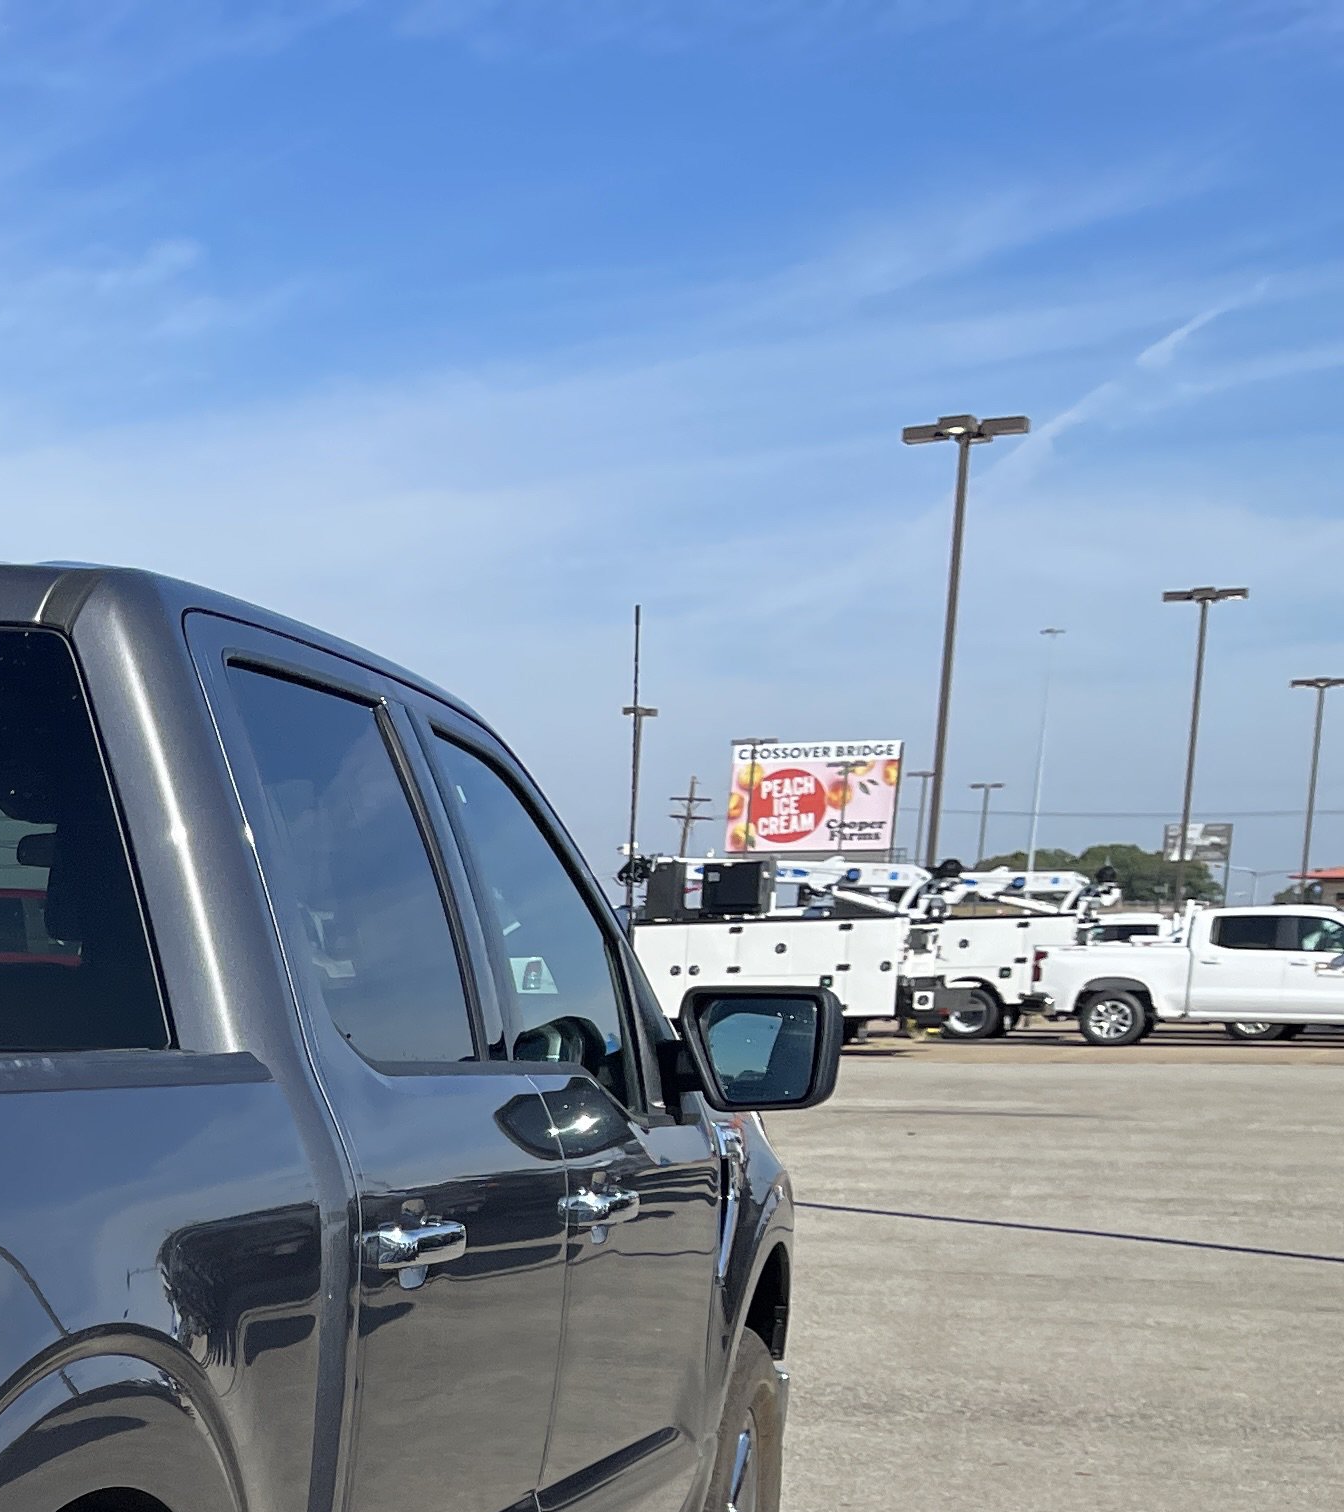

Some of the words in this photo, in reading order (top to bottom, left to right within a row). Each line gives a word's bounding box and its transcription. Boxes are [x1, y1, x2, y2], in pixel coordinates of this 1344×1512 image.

[738, 747, 830, 760] CROSSOVER
[836, 744, 894, 757] BRIDGE
[760, 776, 815, 799] PEACH
[773, 796, 800, 815] ICE
[758, 812, 815, 836] CREAM
[827, 819, 886, 831] Cooper
